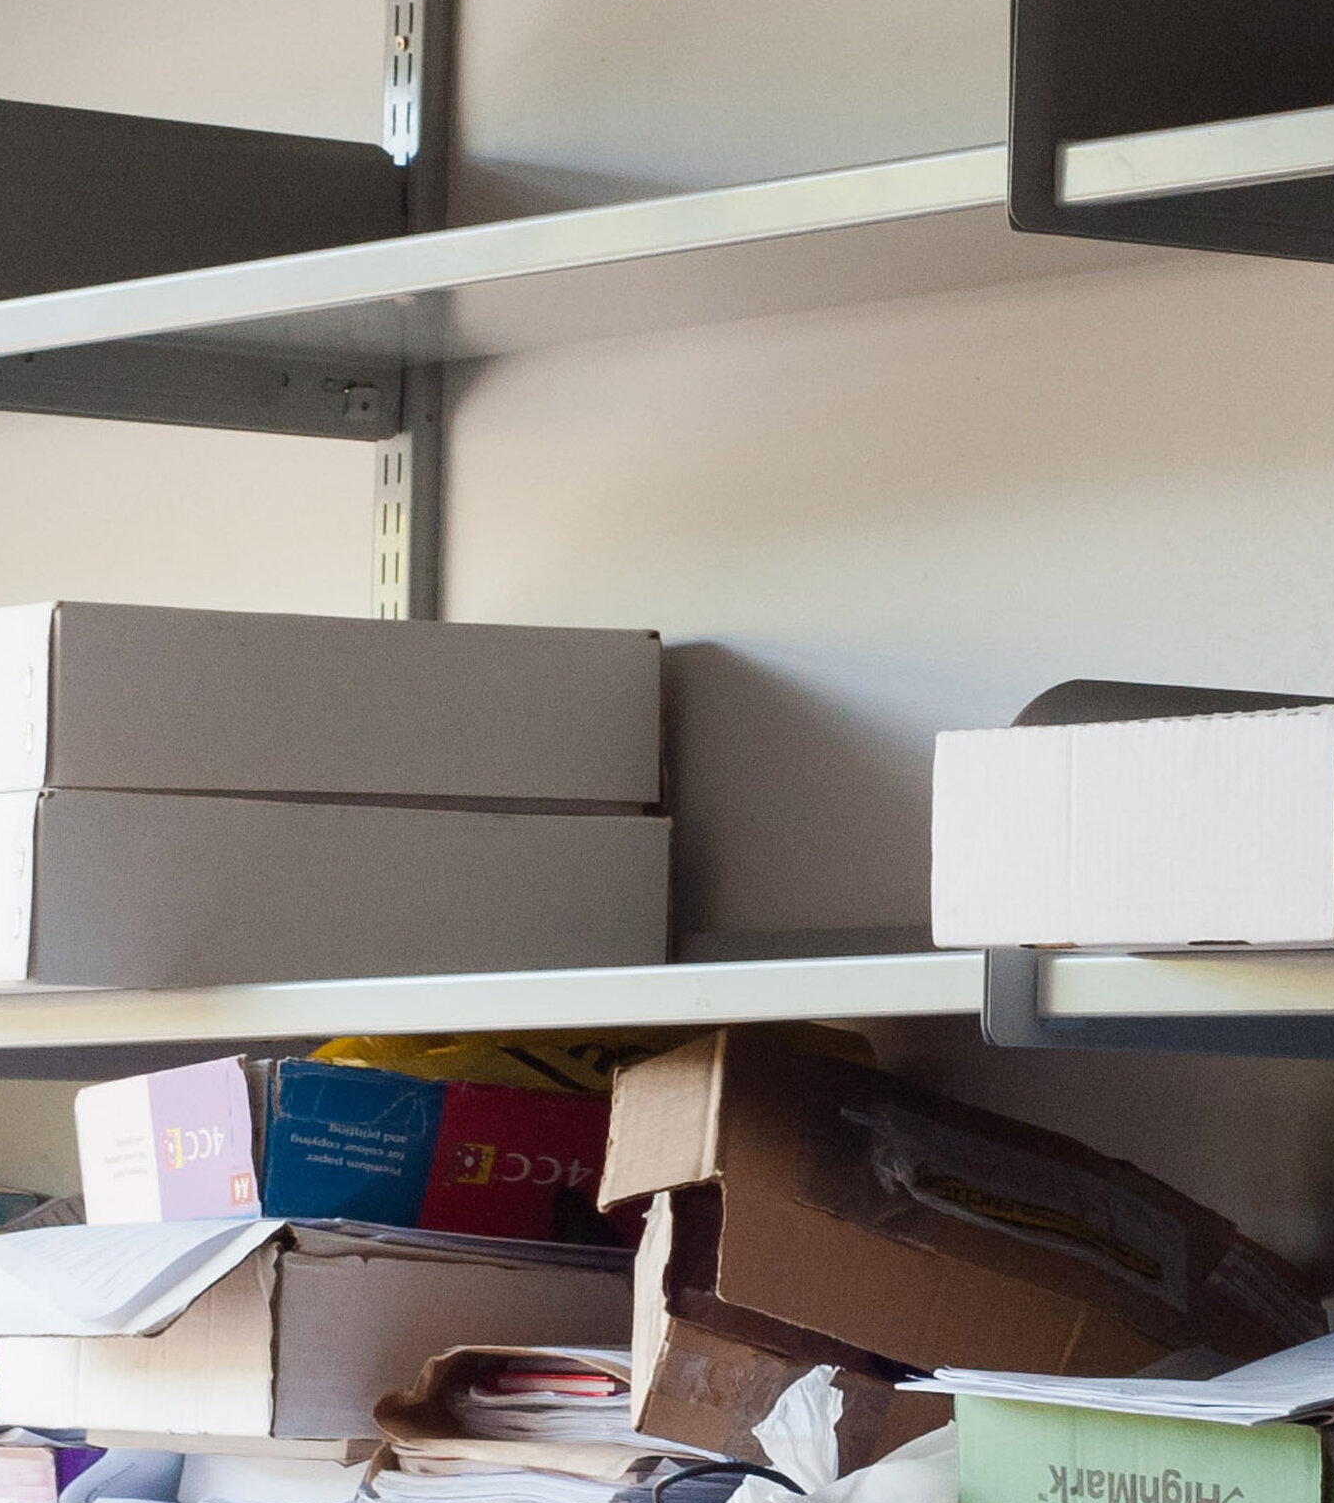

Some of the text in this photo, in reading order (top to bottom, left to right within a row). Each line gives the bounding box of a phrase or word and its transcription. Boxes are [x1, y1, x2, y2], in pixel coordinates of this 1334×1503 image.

[185, 1126, 225, 1160] 4CC
[290, 1133, 341, 1150] copying
[328, 1123, 407, 1145] and printing
[306, 1153, 402, 1177] Premium paper
[387, 1150, 405, 1161] for
[500, 1152, 594, 1188] 4CC
